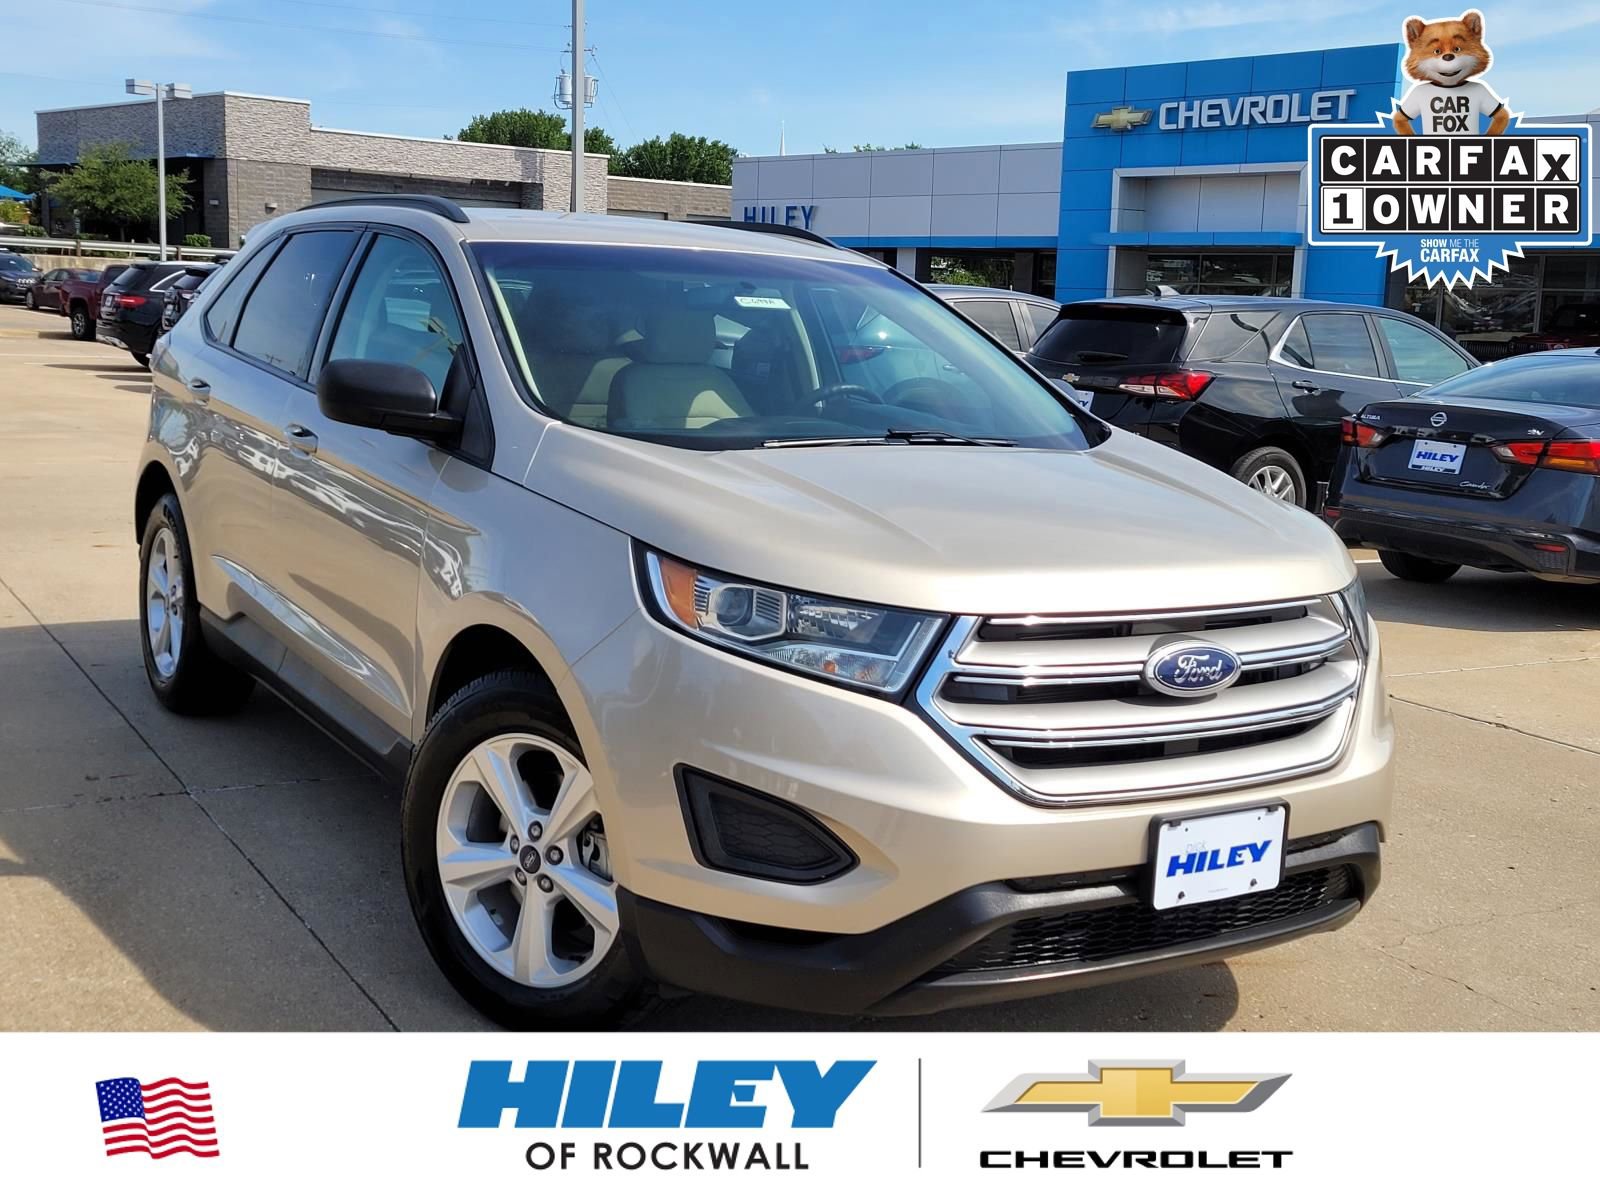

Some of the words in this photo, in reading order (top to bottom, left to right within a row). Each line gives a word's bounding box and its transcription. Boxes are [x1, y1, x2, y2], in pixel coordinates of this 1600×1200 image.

[1159, 89, 1356, 131] CHEVROLET
[1416, 451, 1459, 463] HILEY
[1174, 654, 1223, 684] Ford
[1166, 839, 1273, 878] HILEY
